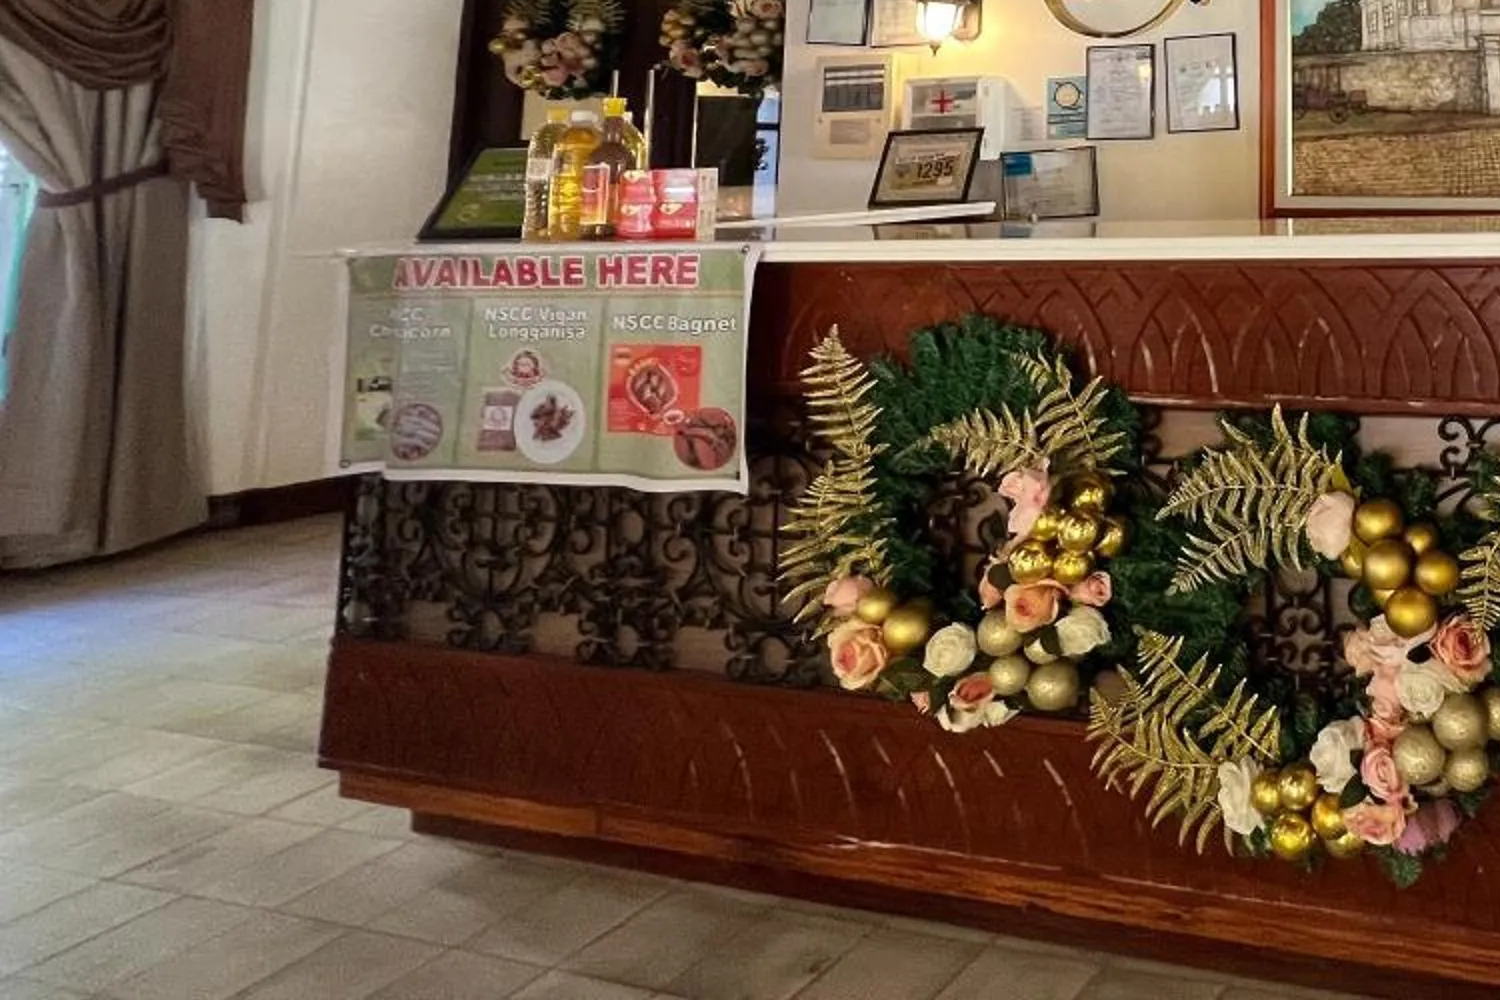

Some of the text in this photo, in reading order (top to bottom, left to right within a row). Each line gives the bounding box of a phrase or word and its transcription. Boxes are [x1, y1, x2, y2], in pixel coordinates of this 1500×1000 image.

[916, 160, 953, 179] 1295
[393, 252, 699, 289] AVAILABLE HERE
[484, 307, 588, 326] NSCC Vigan
[612, 315, 737, 335] NSCC Bagnet
[488, 323, 586, 341] Longganisa
